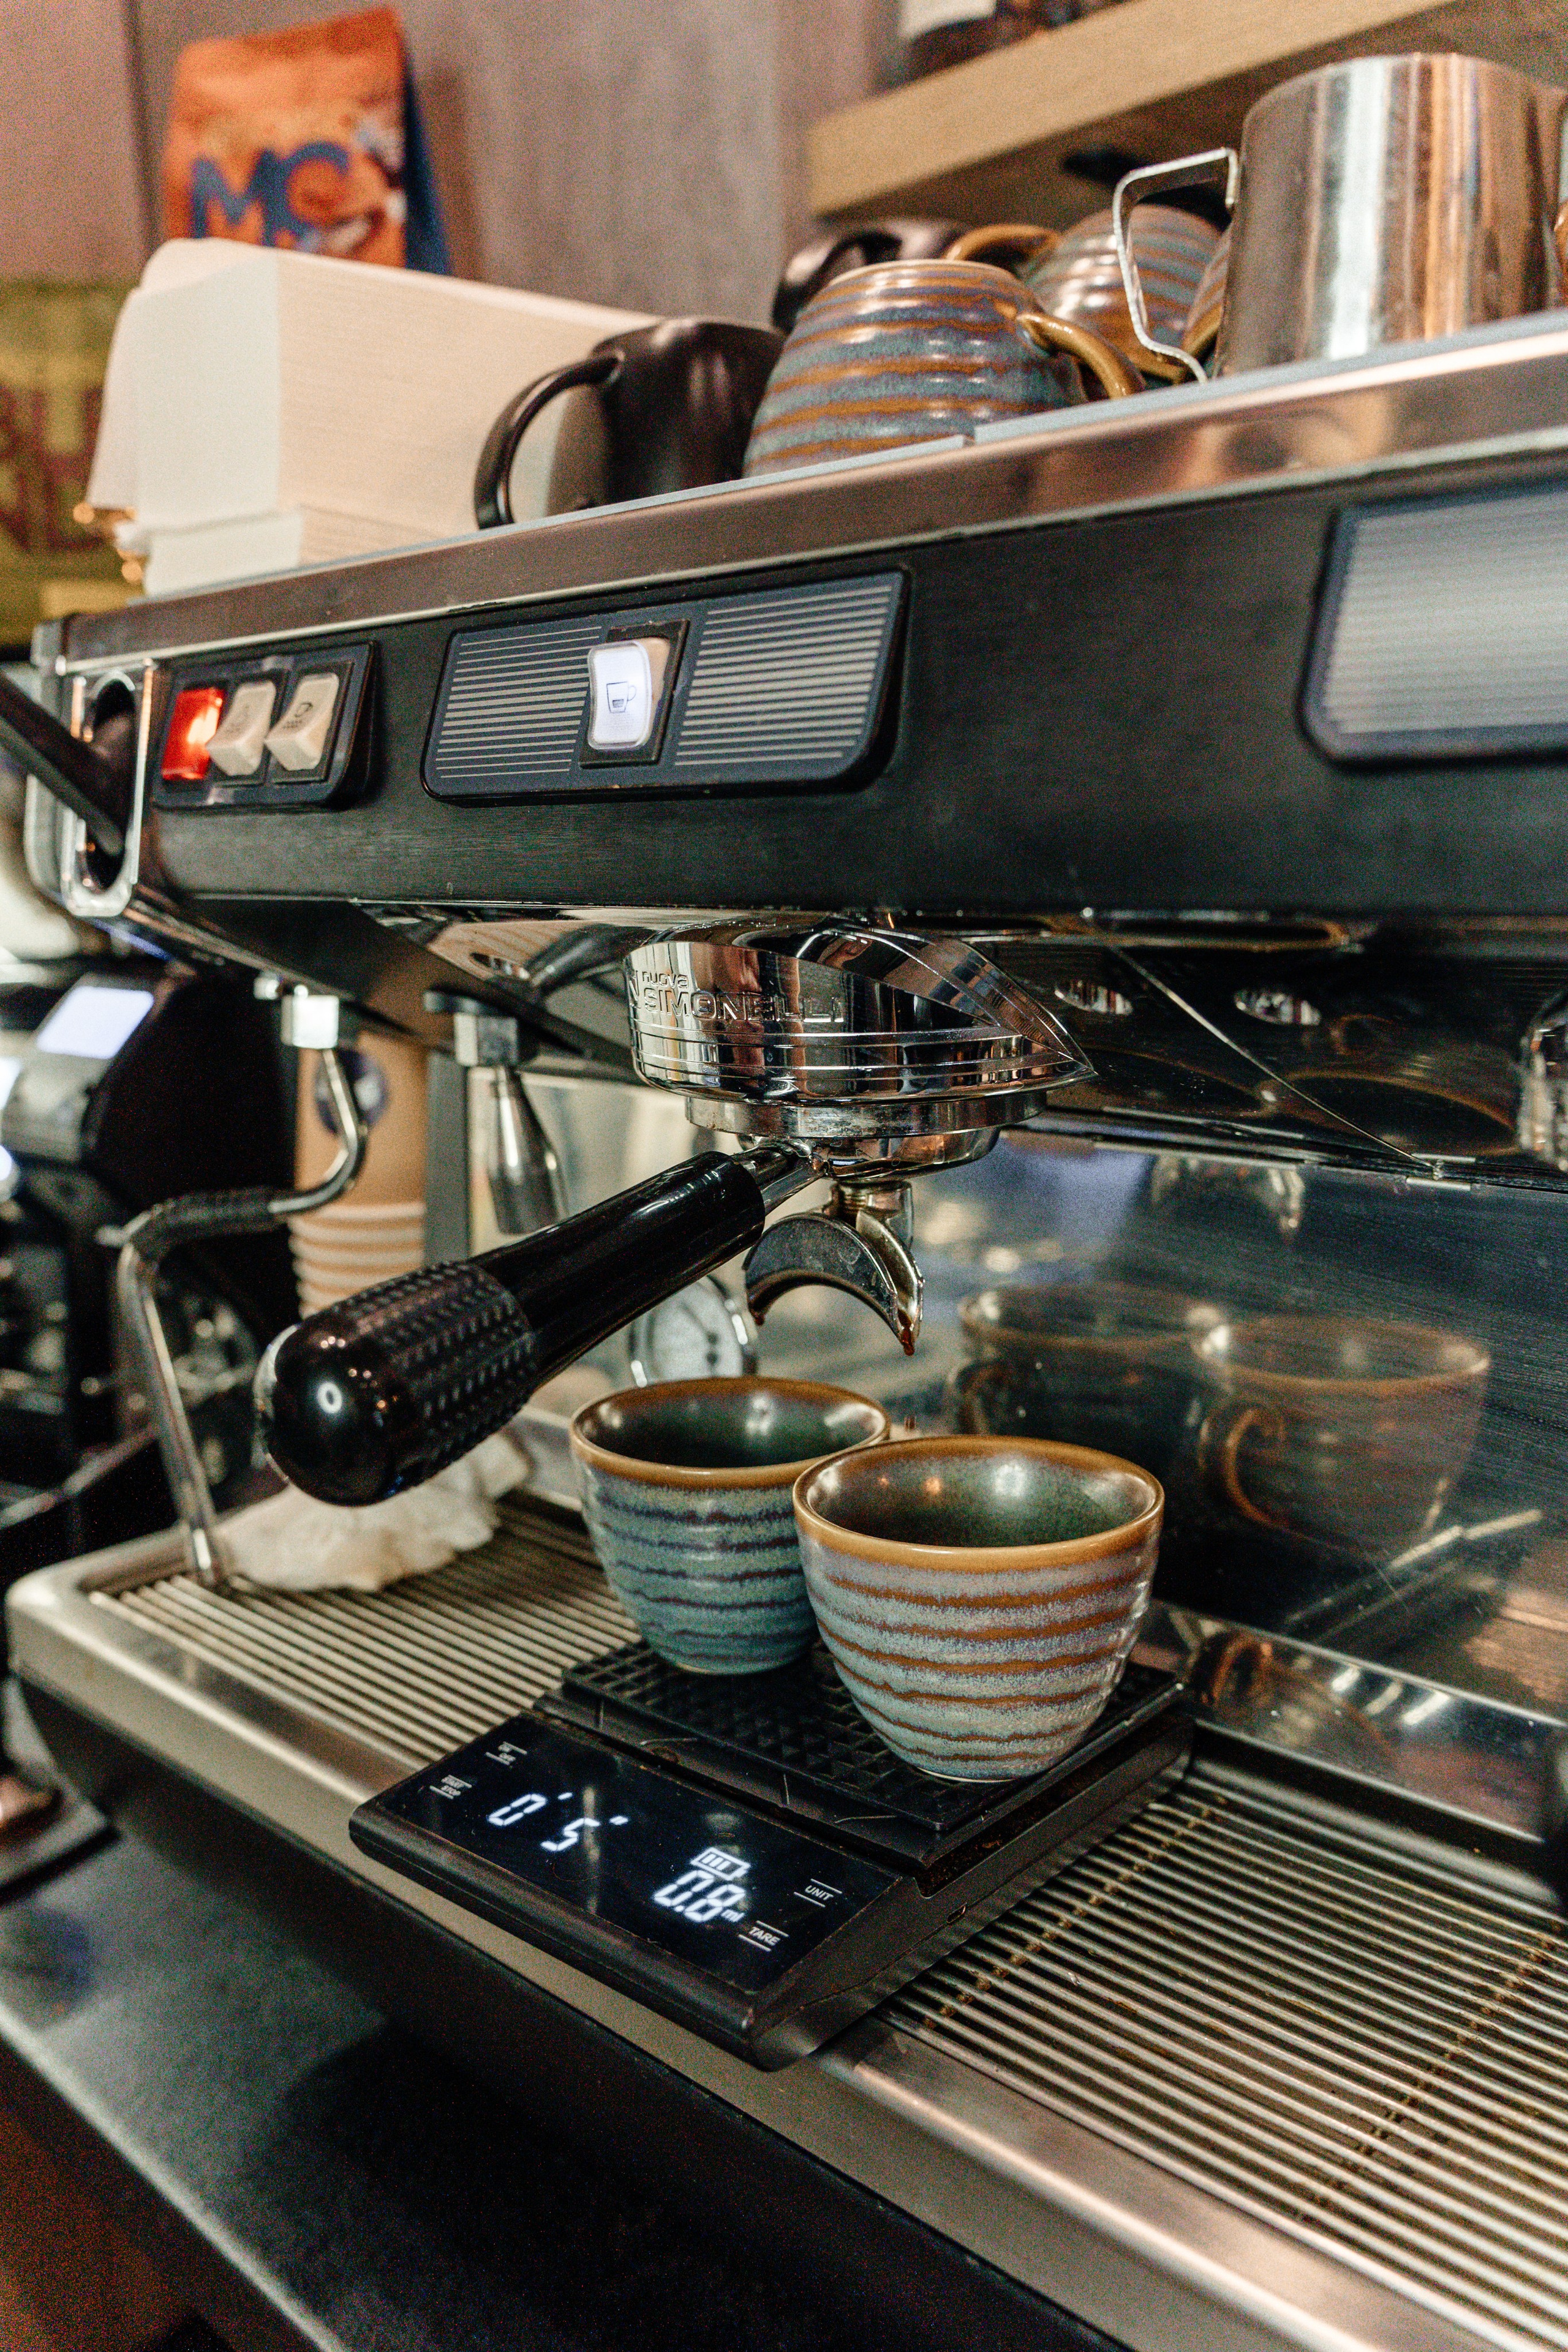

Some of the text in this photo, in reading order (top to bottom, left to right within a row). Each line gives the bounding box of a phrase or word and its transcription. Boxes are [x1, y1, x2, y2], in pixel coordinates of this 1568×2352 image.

[642, 971, 688, 989] nuova
[804, 1885, 834, 1901] UNIT
[748, 1926, 781, 1947] TARE
